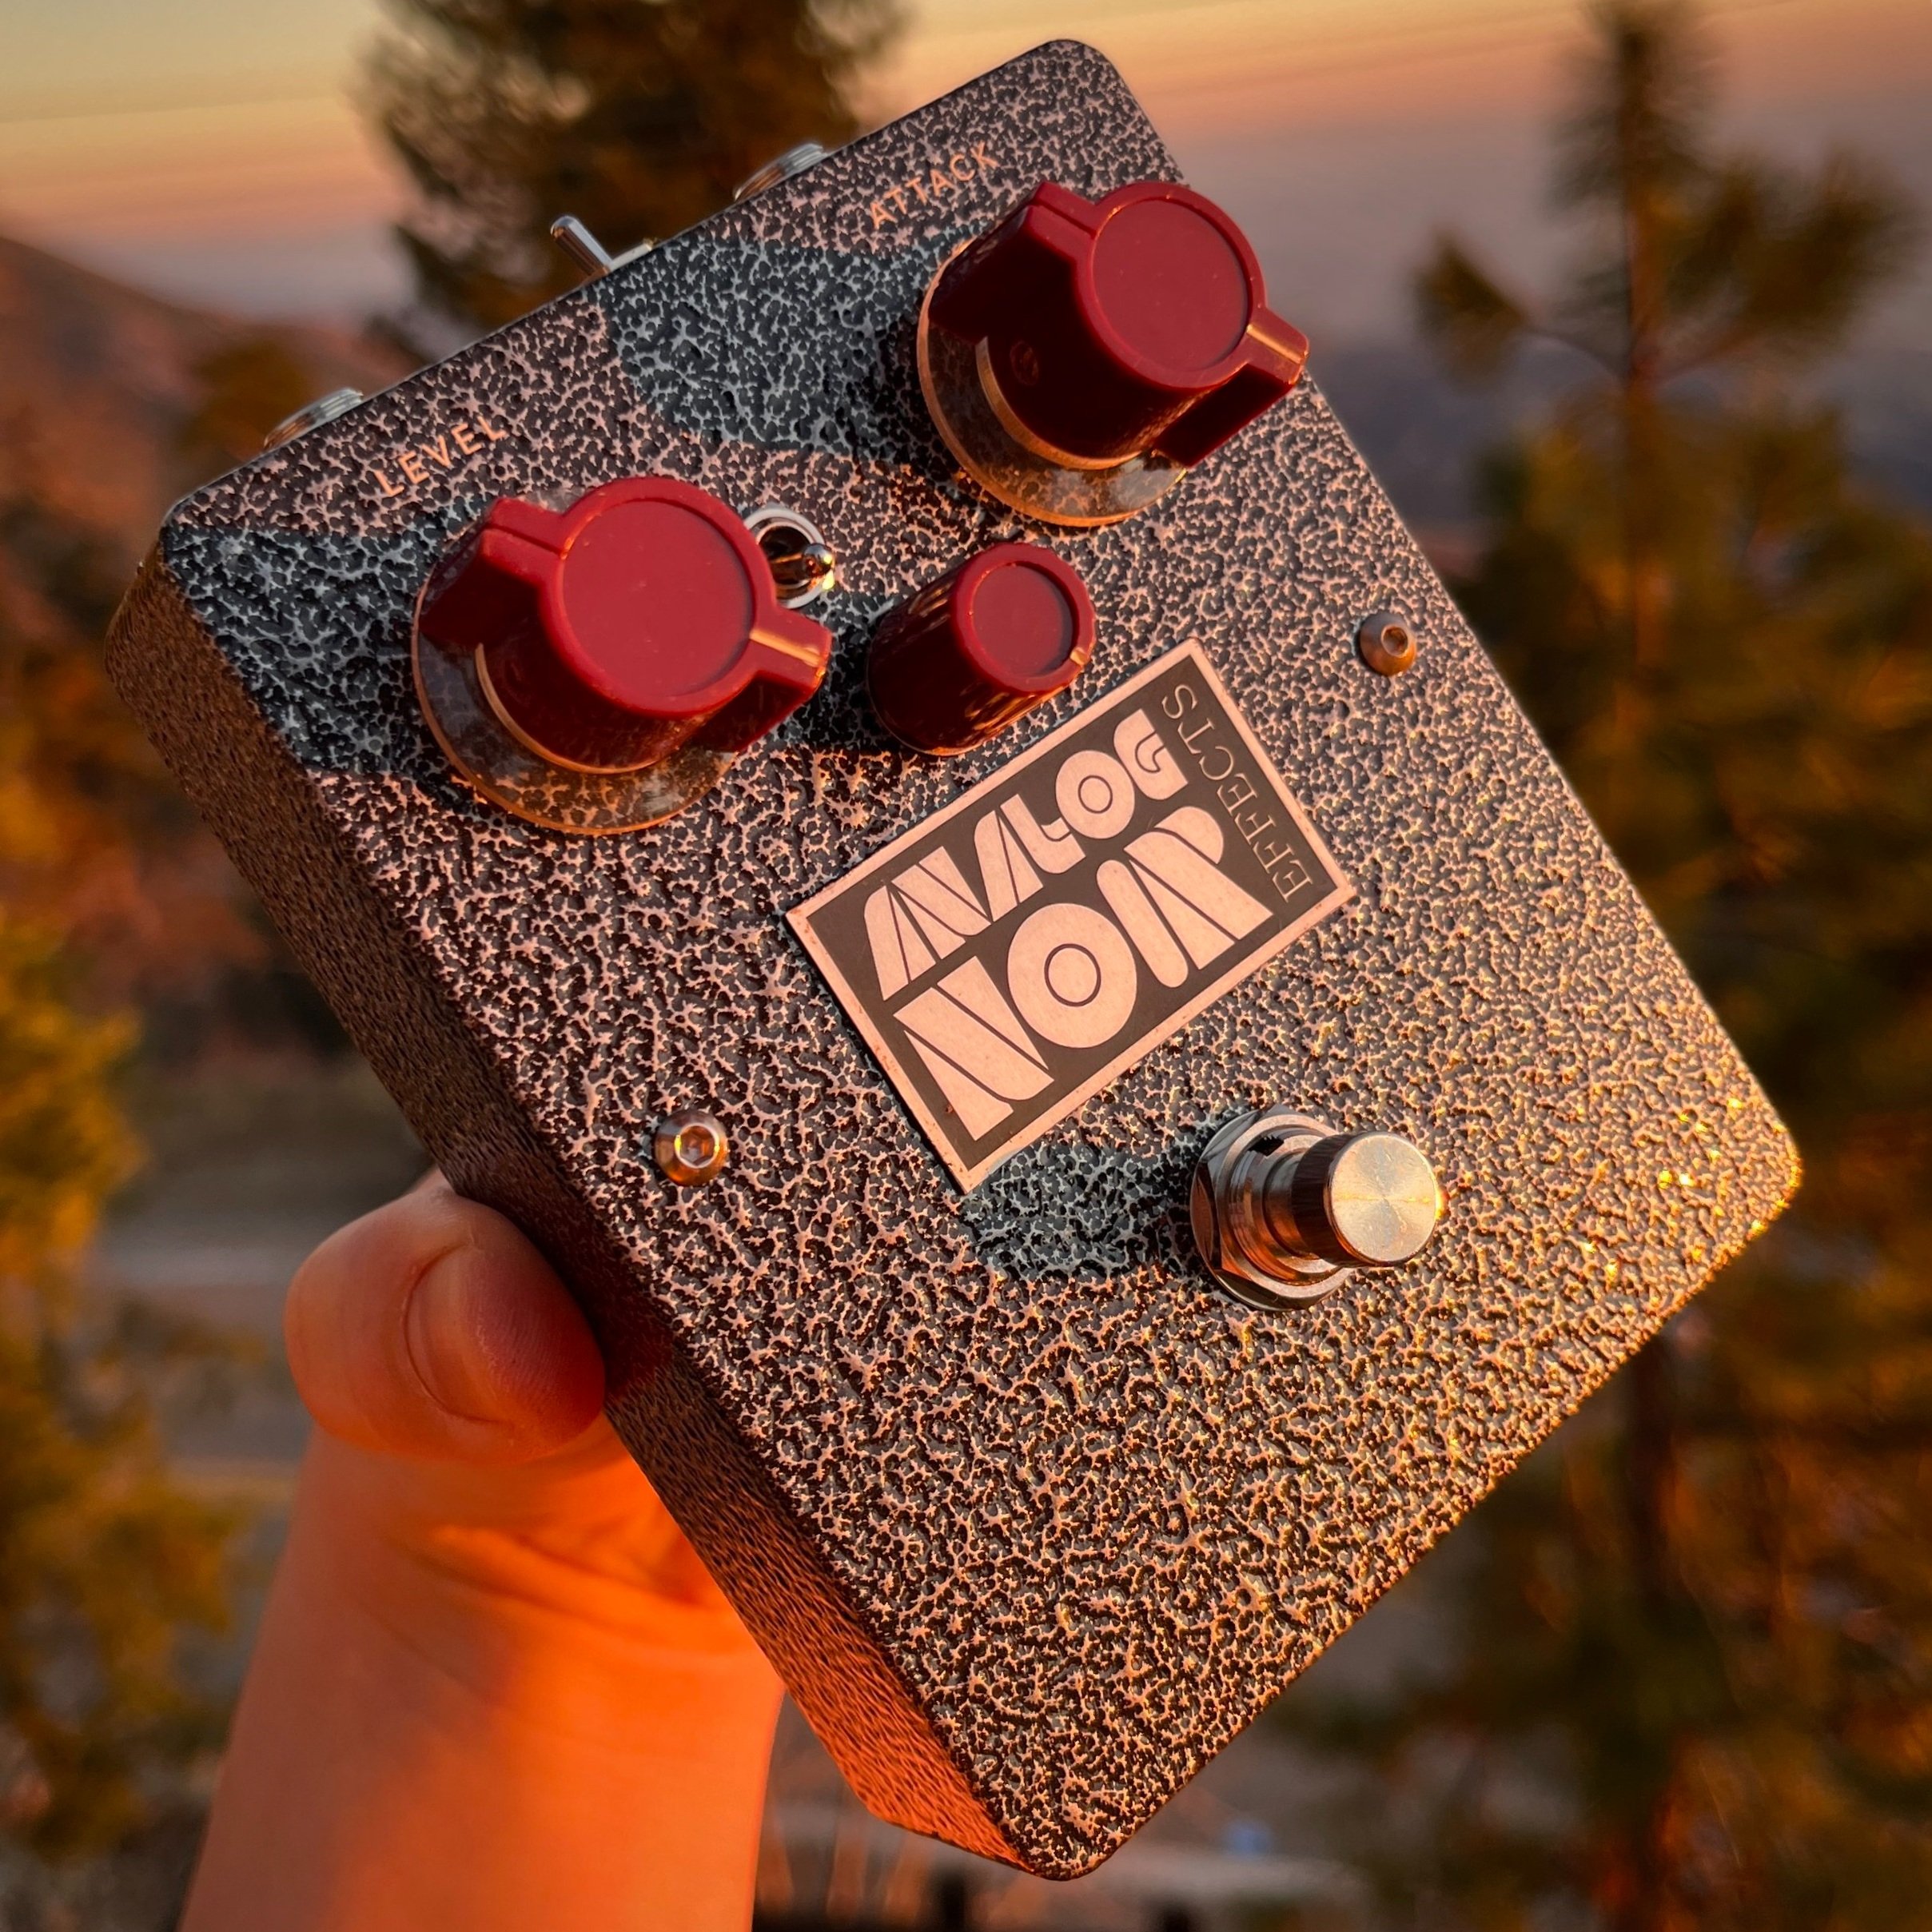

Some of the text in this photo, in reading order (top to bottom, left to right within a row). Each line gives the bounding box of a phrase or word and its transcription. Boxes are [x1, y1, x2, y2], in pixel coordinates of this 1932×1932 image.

[870, 141, 998, 229] ATTACK
[373, 415, 508, 496] LEVEL
[863, 709, 1189, 1001] ANALOG
[1161, 684, 1314, 903] EFFECTS
[893, 806, 1274, 1141] NOIR
